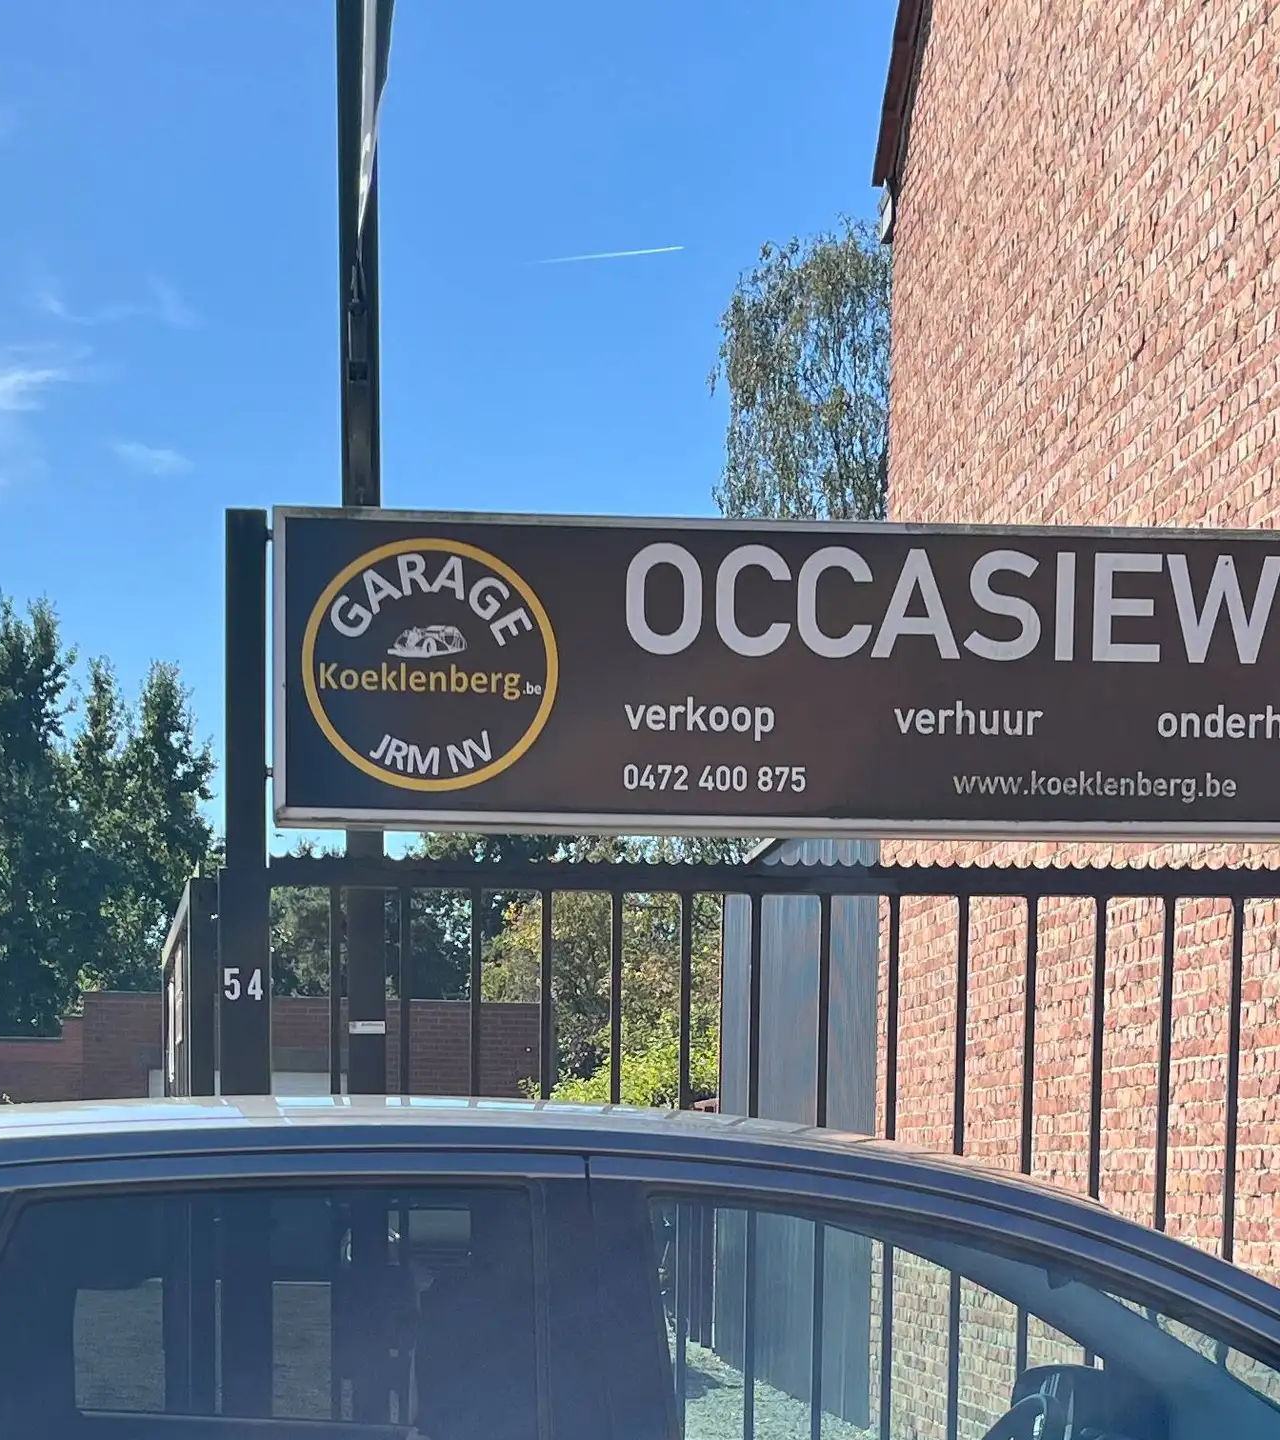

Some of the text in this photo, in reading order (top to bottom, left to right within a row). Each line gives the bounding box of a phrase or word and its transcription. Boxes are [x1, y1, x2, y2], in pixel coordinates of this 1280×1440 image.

[330, 553, 533, 647] GARAGE
[625, 696, 775, 742] verkoop
[894, 700, 1044, 736] verhuur
[369, 730, 493, 776] JRM NV
[623, 763, 806, 793] 0472 400 875
[952, 770, 1237, 803] www.koeklenberg.be
[224, 967, 264, 1001] 54
